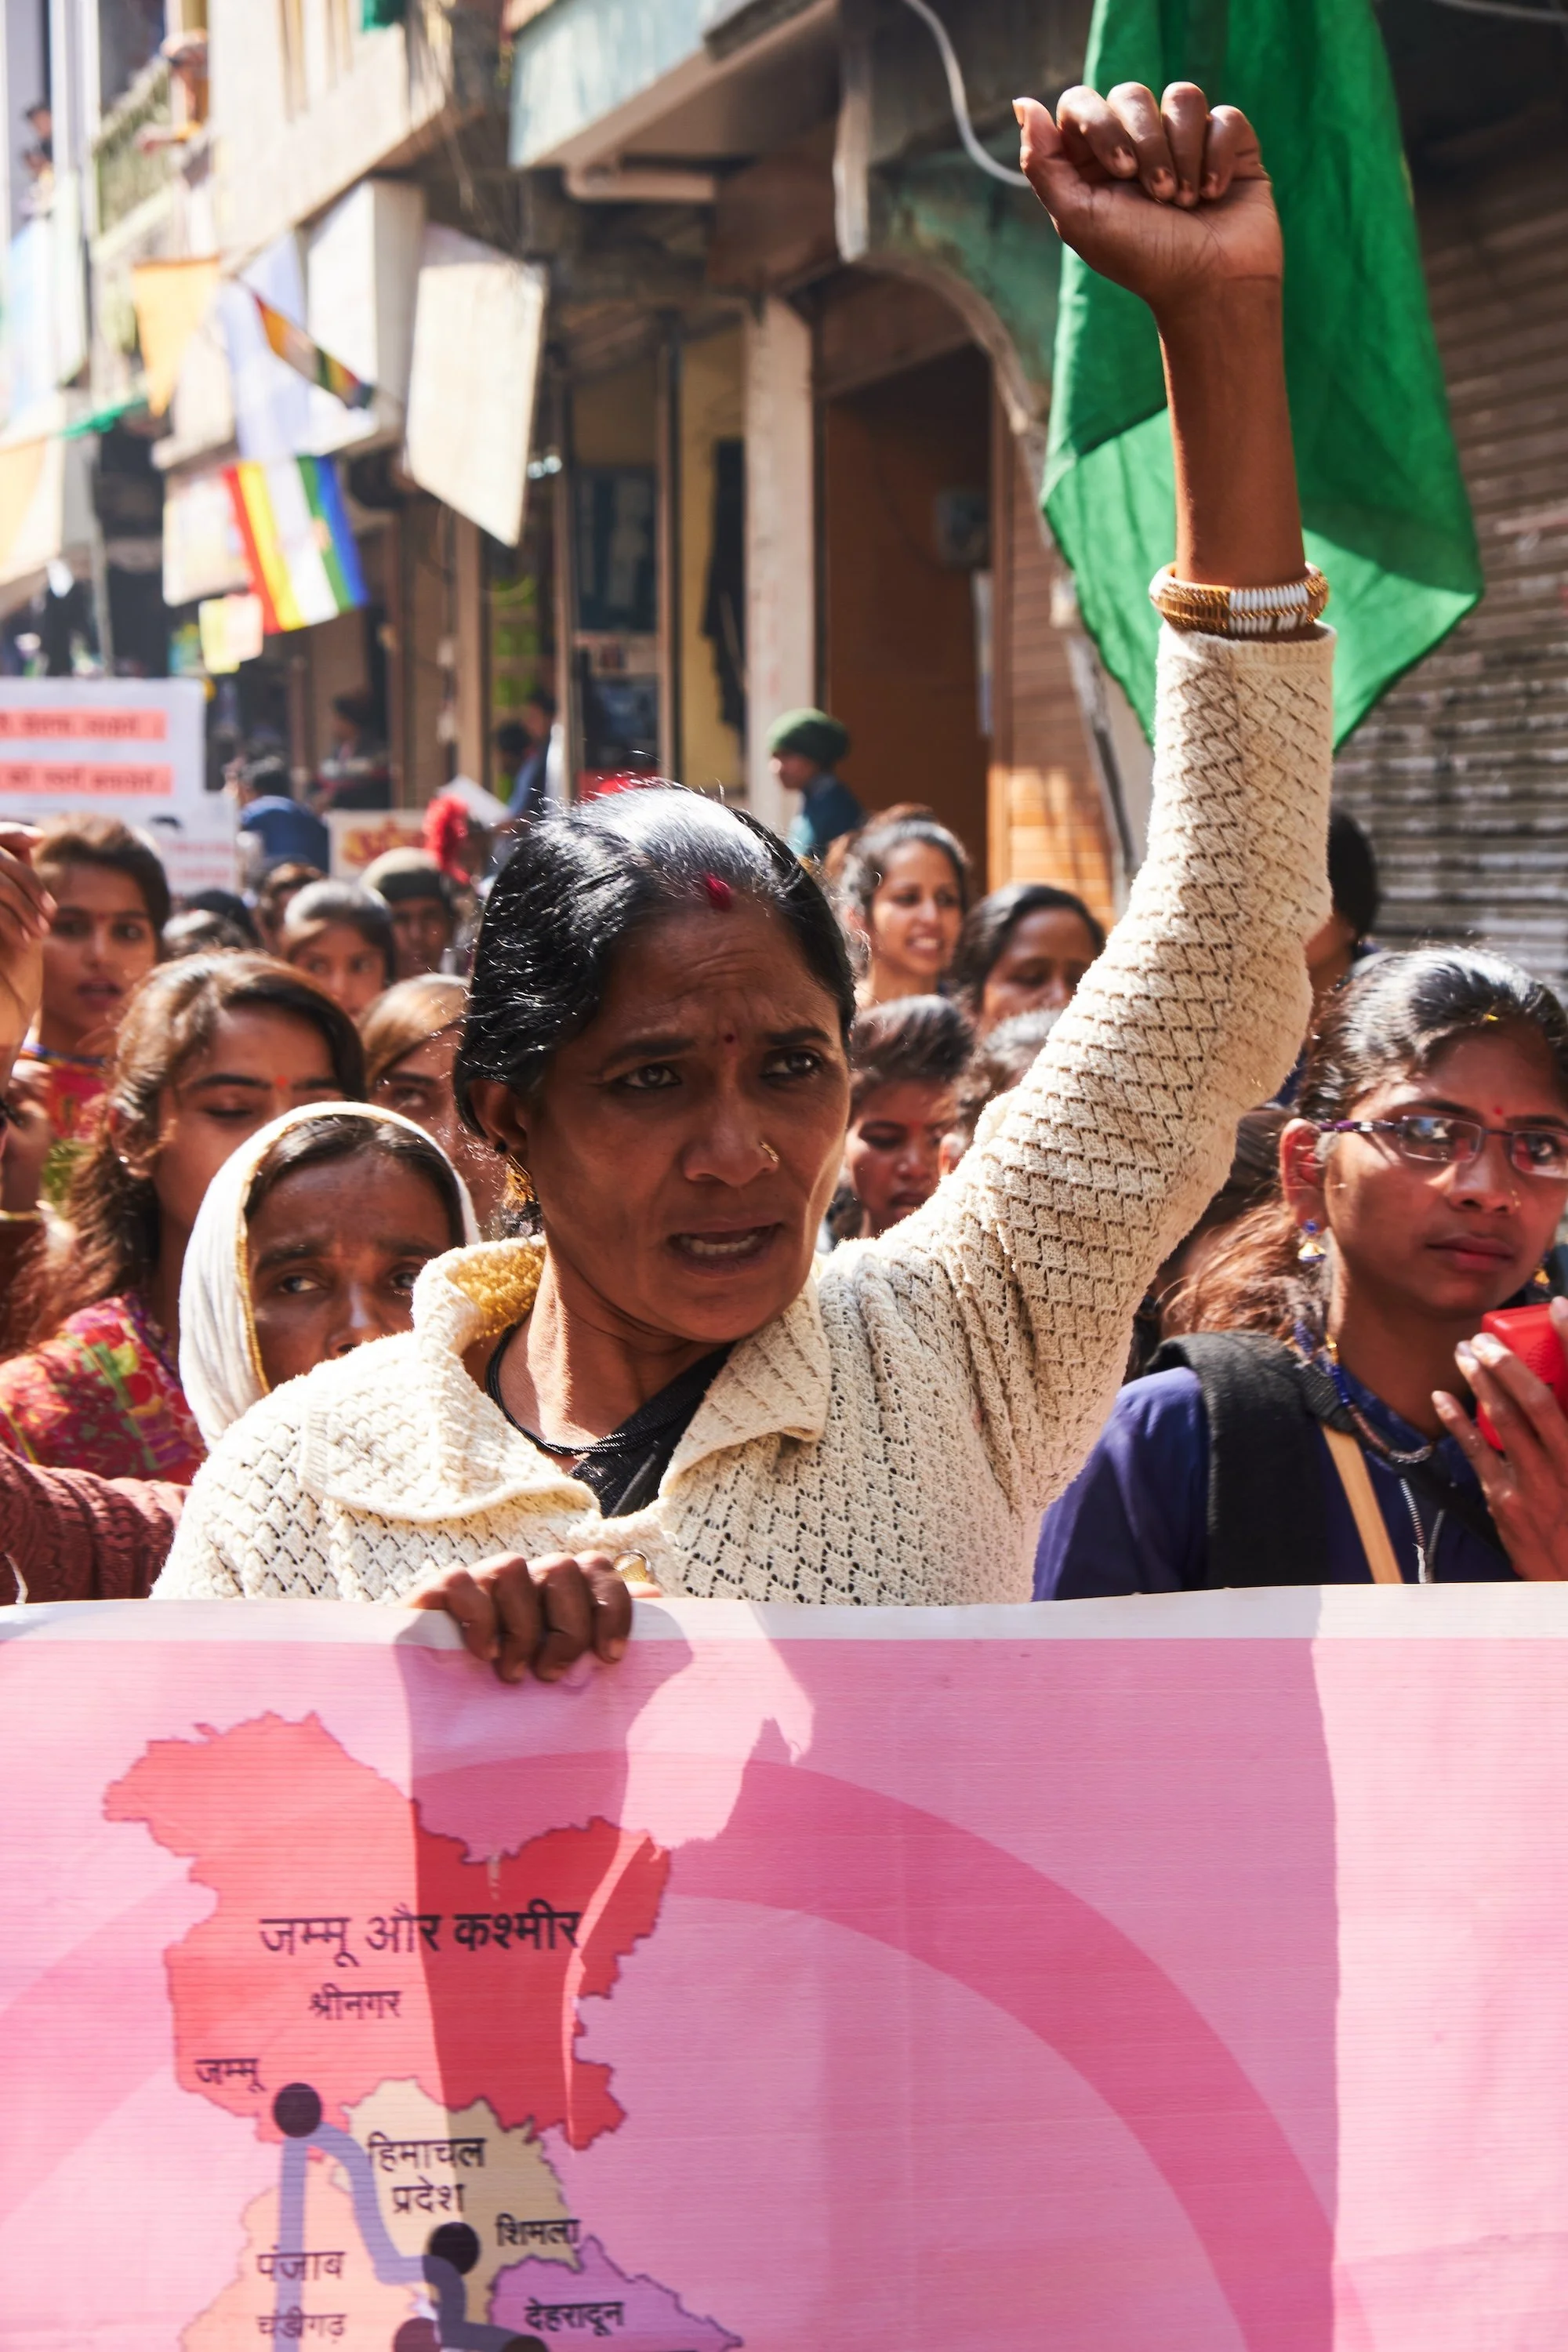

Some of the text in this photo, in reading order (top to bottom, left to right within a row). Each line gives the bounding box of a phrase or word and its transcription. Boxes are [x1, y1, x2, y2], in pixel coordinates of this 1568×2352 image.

[260, 1898, 580, 1967] जम्मू और कश्मीर
[310, 1983, 401, 2020] श्रीनगर
[194, 2058, 267, 2092] जम्मू
[368, 2131, 487, 2172] हिमाचल
[392, 2176, 465, 2213] प्रदेश
[495, 2212, 580, 2247] शिमला
[524, 2297, 624, 2336] देहरादून
